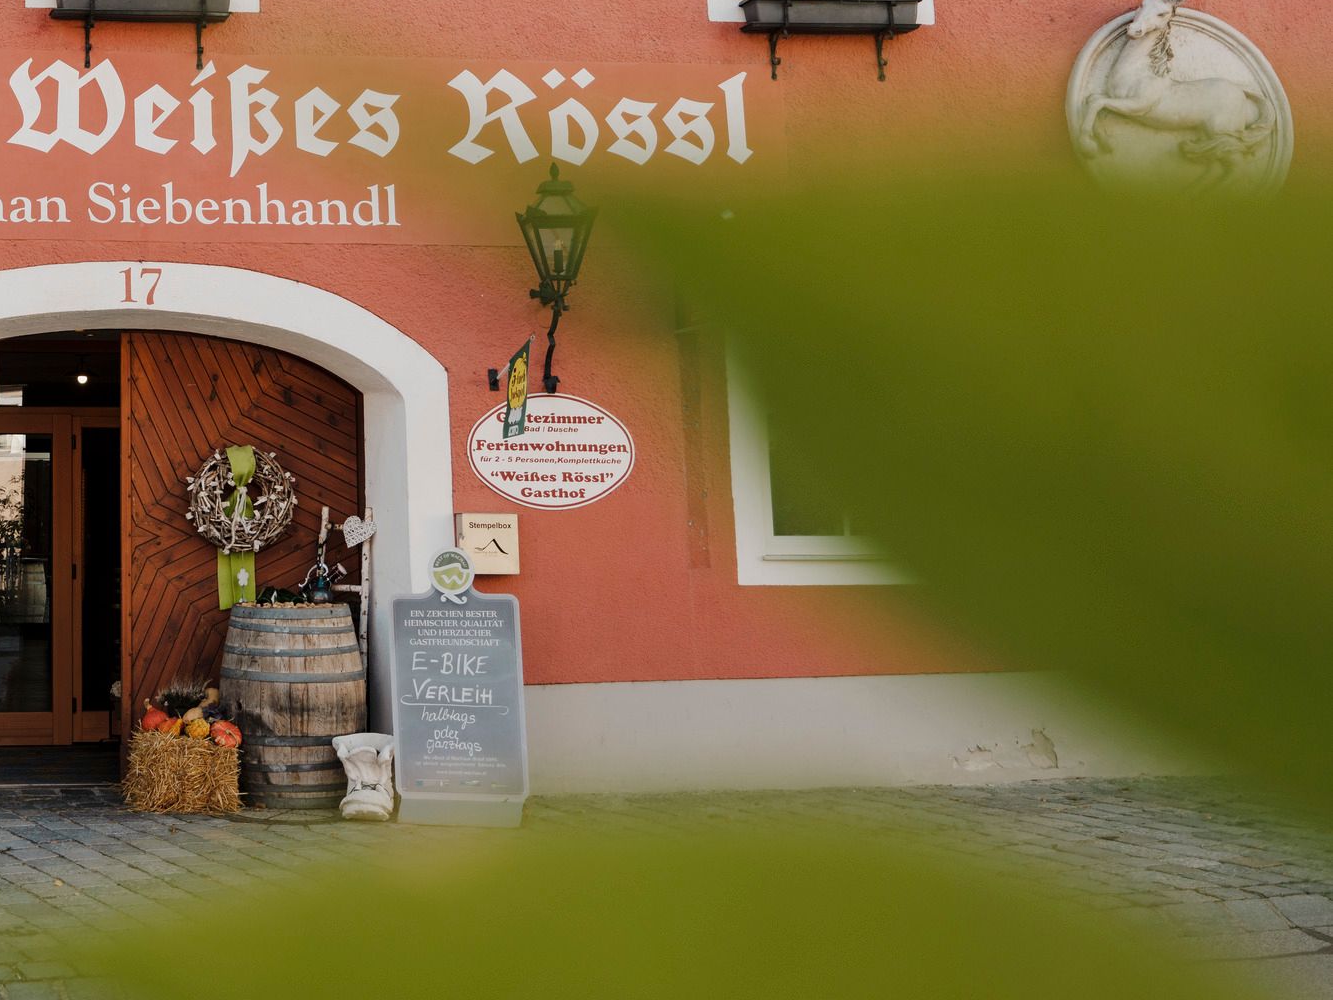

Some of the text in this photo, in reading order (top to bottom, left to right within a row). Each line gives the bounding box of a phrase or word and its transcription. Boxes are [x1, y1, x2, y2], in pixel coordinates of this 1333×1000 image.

[7, 58, 401, 178] Weißes
[446, 67, 754, 166] Rössl
[87, 183, 402, 227] Siebenhandl
[119, 267, 162, 305] 17
[496, 412, 605, 424] Gtezimmer
[476, 440, 627, 455] Ferienwohnungen
[521, 487, 586, 498] Gasthof
[469, 521, 512, 530] Stempelbox
[404, 618, 504, 628] HEIMISCHER QUALITÄT
[438, 629, 492, 637] HERZLICHER
[409, 638, 500, 647] GASTFREUNDSCHAFT
[411, 651, 489, 676] E-BIKE
[421, 706, 476, 730] halbtags
[434, 725, 459, 740] oder
[426, 739, 483, 757] ganztags
